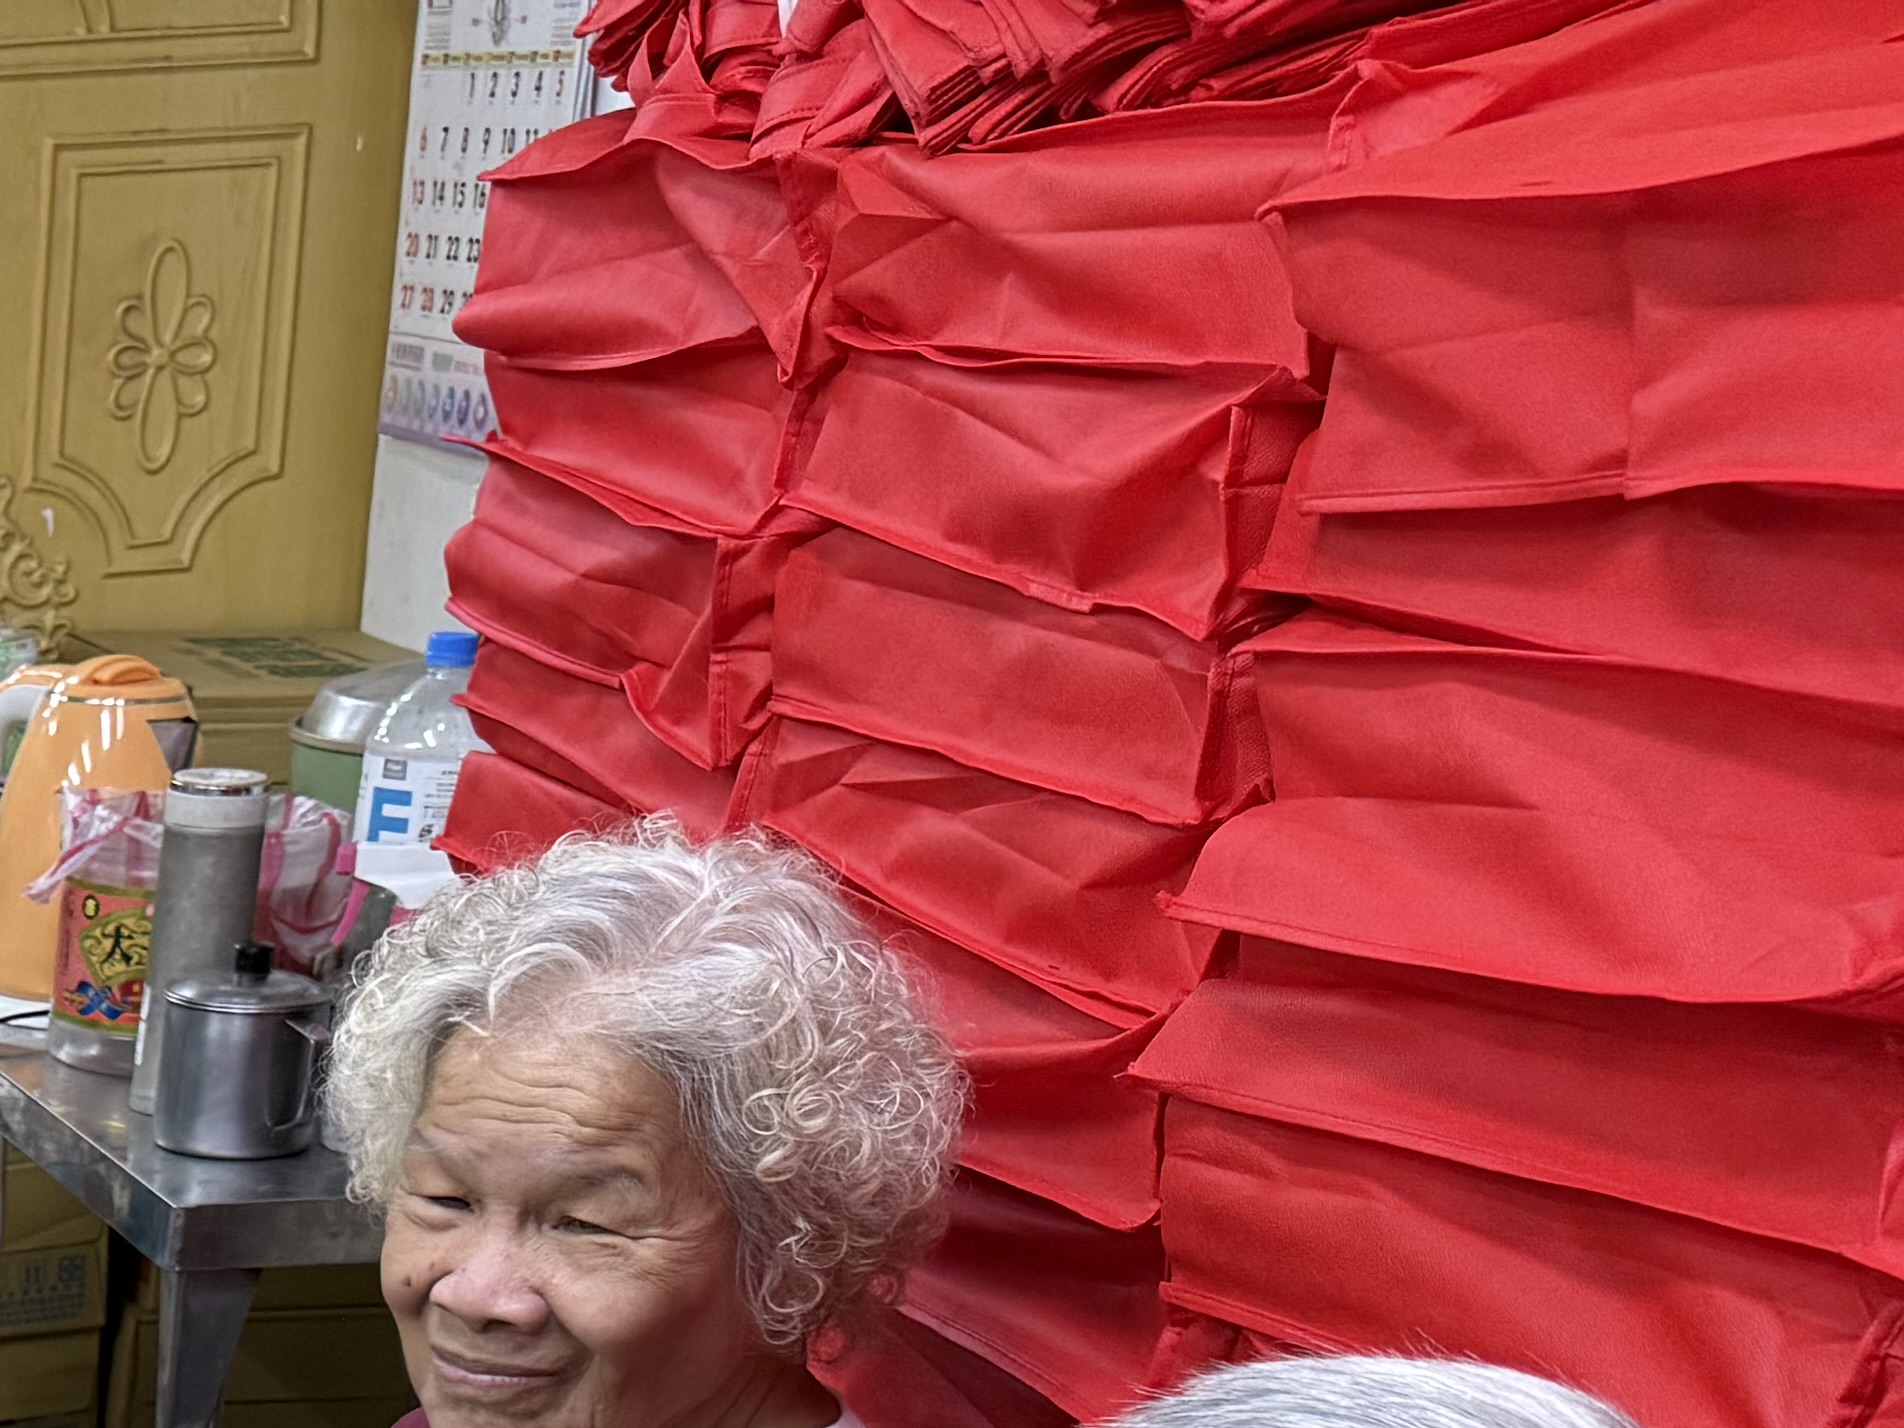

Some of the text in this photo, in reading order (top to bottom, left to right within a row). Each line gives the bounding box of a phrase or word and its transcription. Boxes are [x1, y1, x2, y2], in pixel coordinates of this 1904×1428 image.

[489, 71, 498, 98] 2
[510, 71, 520, 98] 3
[534, 70, 543, 98] 4
[440, 126, 449, 152] 7
[482, 127, 491, 154] 9
[502, 128, 516, 154] 10
[432, 180, 445, 207] 14
[453, 181, 466, 208] 15
